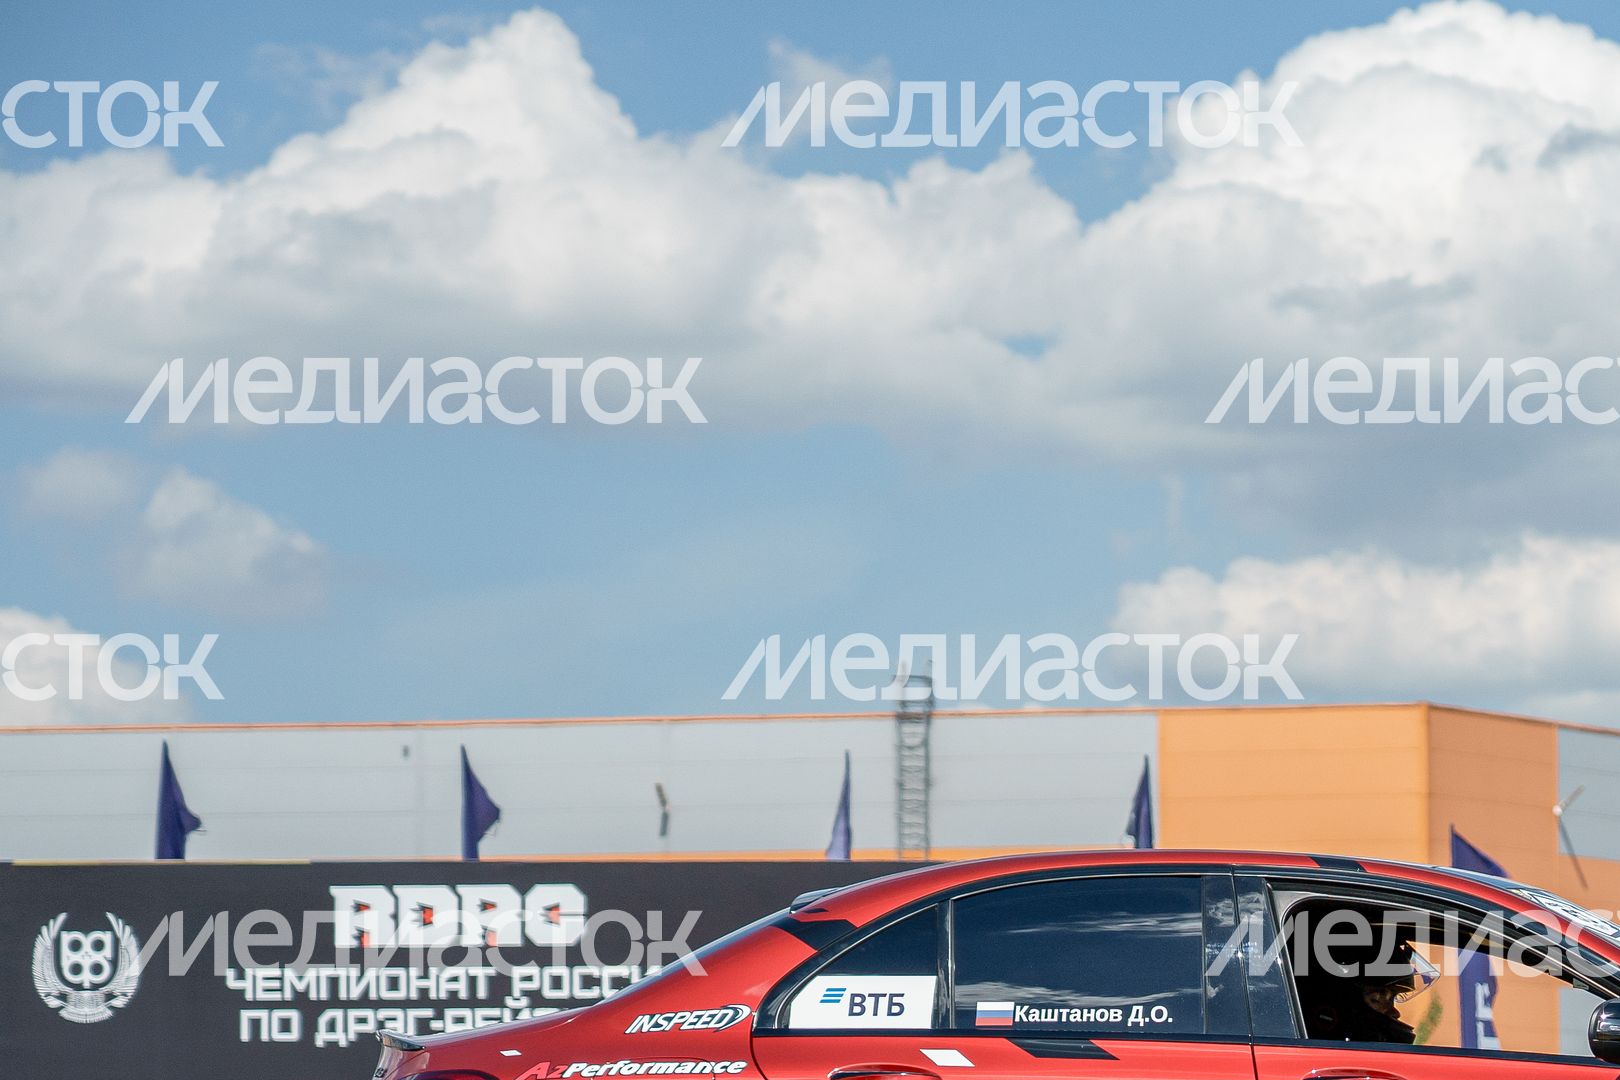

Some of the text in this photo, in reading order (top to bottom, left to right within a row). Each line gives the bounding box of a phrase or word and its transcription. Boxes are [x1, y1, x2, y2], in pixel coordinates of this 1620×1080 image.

[225, 966, 497, 1000] ЧЕМПИОНАТ
[624, 1004, 750, 1034] INSPEED
[848, 993, 905, 1017] ВТБ
[1014, 1005, 1173, 1026] Каштанов Д.О.
[240, 1008, 302, 1042] ПО
